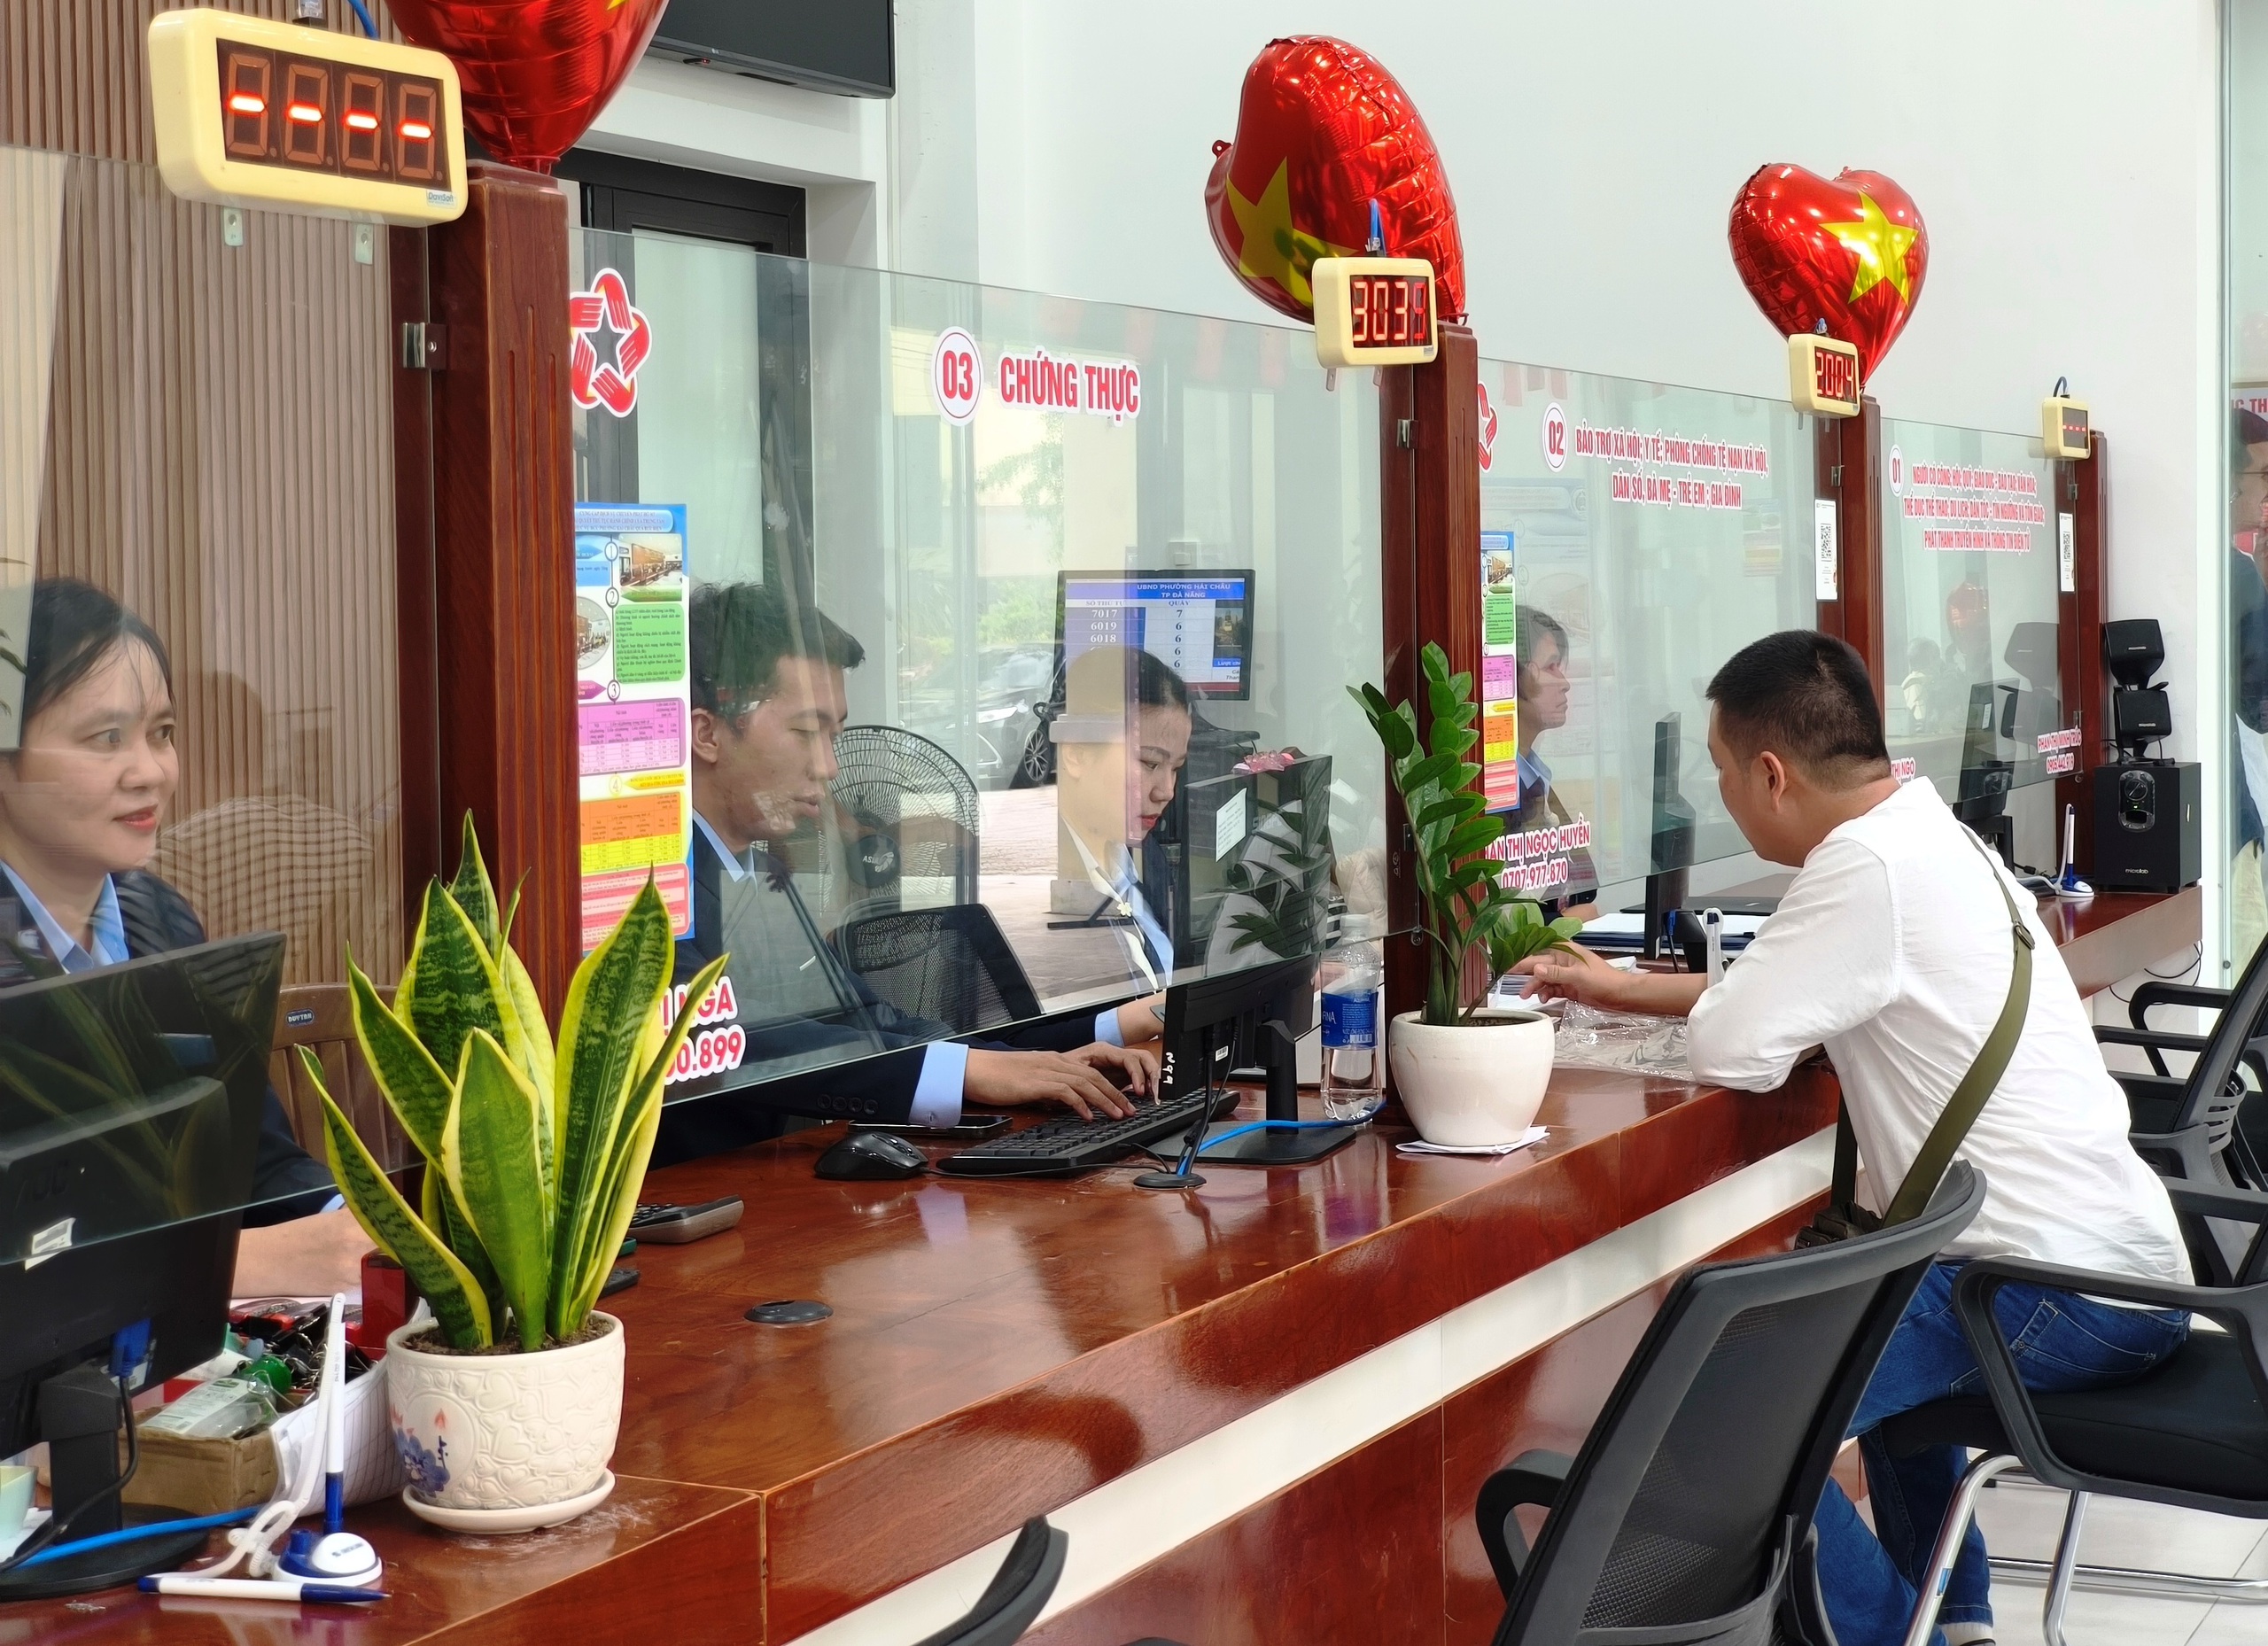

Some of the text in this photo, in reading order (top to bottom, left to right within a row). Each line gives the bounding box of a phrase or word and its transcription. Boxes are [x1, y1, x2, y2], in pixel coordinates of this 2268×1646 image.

[943, 350, 1138, 421] 03 CHỨNG THỰC
[1816, 352, 1854, 399] 2004
[1549, 420, 1564, 455] 02
[1576, 422, 1593, 453] BẢO
[1596, 430, 1612, 461] TRỢ
[1644, 437, 1650, 460] Y
[1665, 435, 1689, 463] PHÒNG
[1692, 437, 1716, 467] CHỐNG
[1728, 446, 1742, 473] NẠN
[1892, 458, 1900, 484] 01
[1612, 470, 1629, 499] DÂN
[1647, 473, 1658, 501] BÀ
[1659, 479, 1671, 507] MẸ
[1678, 475, 1691, 504] TRẺ
[1694, 482, 1705, 504] EM
[1711, 483, 1722, 506] GIA
[610, 590, 615, 605] 2
[1091, 609, 1118, 618] 7017
[1177, 609, 1183, 618] 7
[1090, 634, 1116, 643] 6018
[1175, 634, 1182, 643] 6
[1174, 647, 1181, 656] 6
[611, 683, 617, 698] 3
[1507, 837, 1524, 866] THỊ
[1526, 832, 1557, 859] NGỌC
[1559, 816, 1589, 849] HUYỀN
[1503, 861, 1567, 889] 0707.977.870
